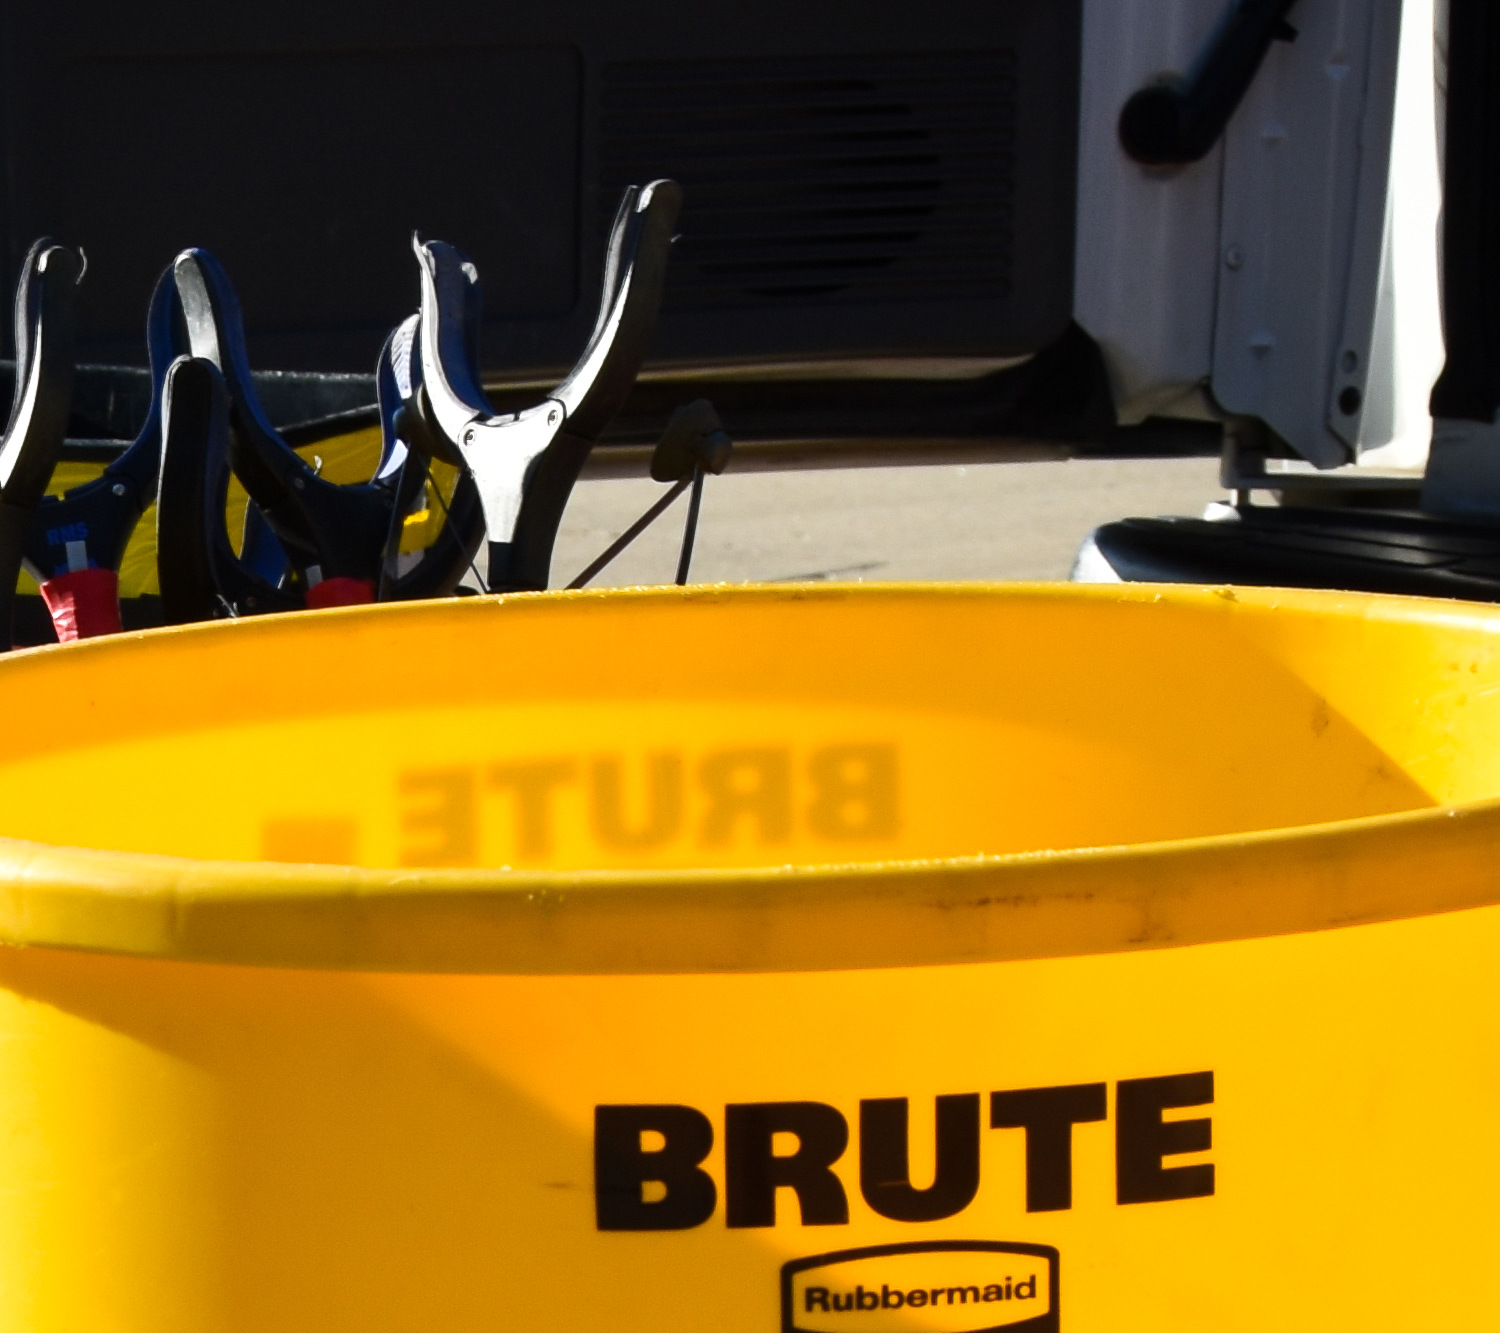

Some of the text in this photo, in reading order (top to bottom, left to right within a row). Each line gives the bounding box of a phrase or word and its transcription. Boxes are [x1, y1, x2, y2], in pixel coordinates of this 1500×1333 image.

[46, 521, 90, 545] RMS
[594, 1070, 1215, 1232] BRUTE
[804, 1273, 1037, 1313] Rubbermaid
